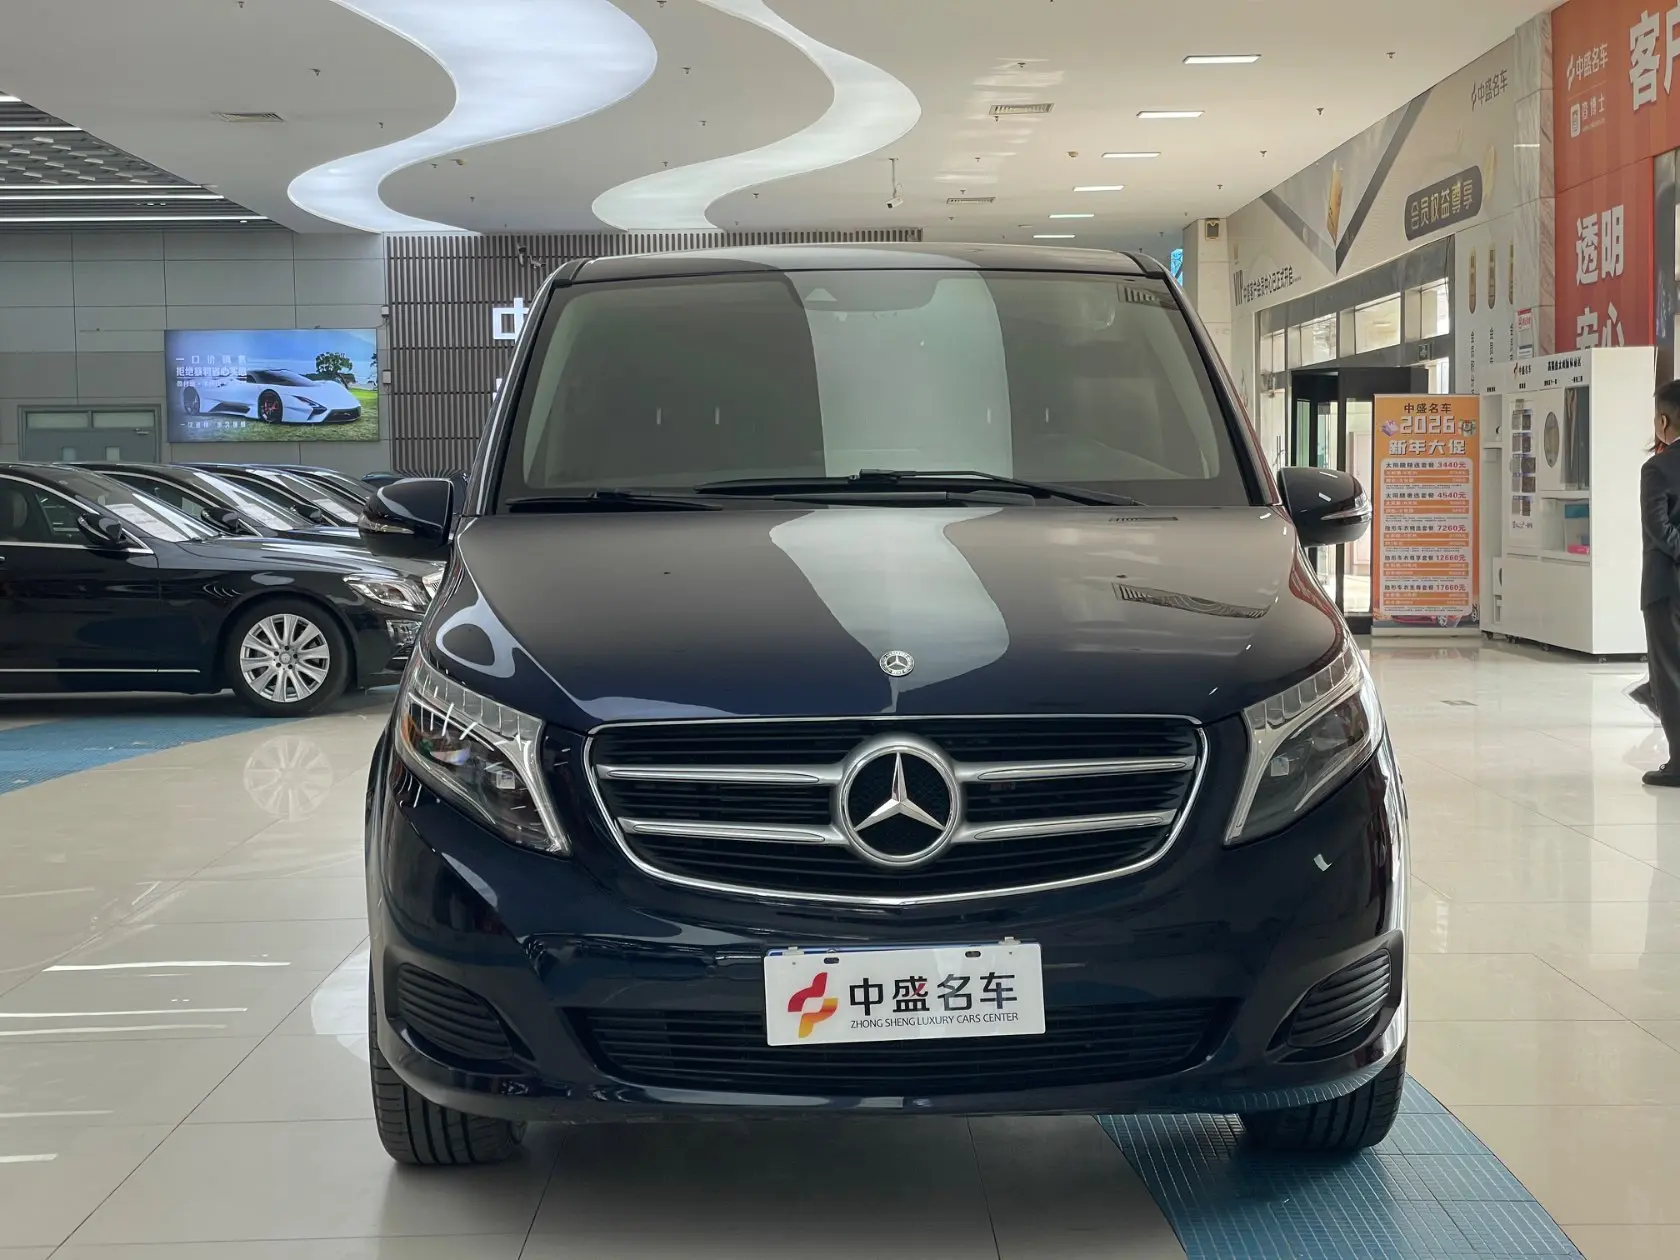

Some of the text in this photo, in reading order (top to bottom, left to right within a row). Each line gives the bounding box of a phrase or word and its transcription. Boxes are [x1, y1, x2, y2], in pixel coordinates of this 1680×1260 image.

[1576, 42, 1608, 80] 中盛名车
[1477, 69, 1508, 105] 中盛名车
[1411, 179, 1473, 230] 会员权益尊享
[1576, 204, 1624, 286] 透明
[1404, 403, 1452, 414] 中盛名车
[1400, 415, 1455, 434] 2026
[1389, 440, 1466, 455] 新年大促
[1437, 461, 1467, 469] 3440元
[1437, 491, 1467, 499] 4540元
[1437, 524, 1466, 532] 7260元
[850, 972, 1017, 1016] 中盛名车
[851, 1012, 1019, 1028] ZHONG SHENG LUXURY CARS CENTER
